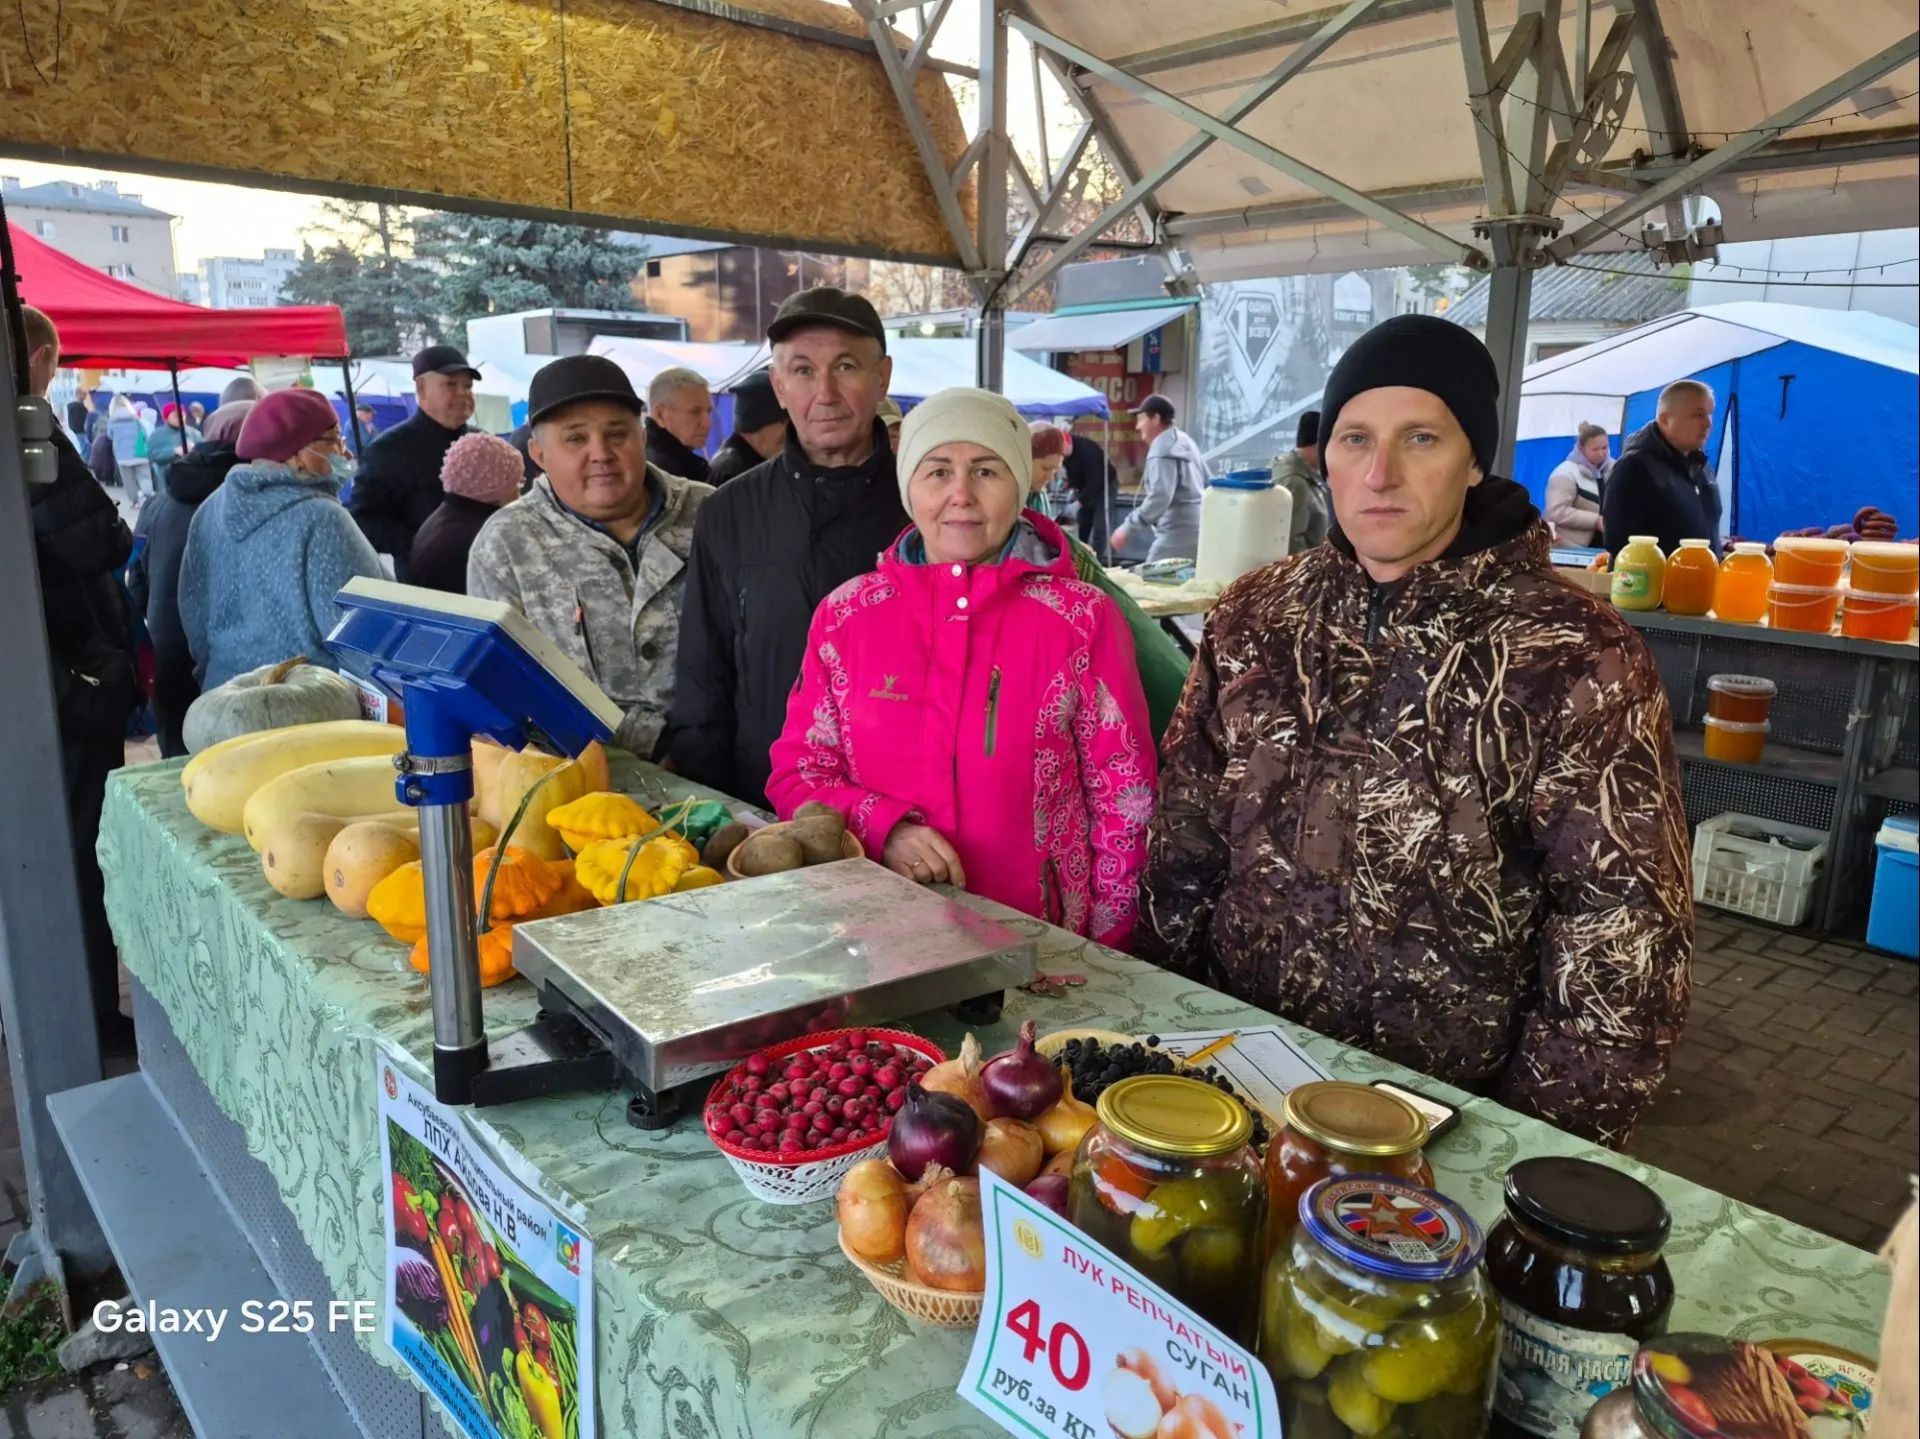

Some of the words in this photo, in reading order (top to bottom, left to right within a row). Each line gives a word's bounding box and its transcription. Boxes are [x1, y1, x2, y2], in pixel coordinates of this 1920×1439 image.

[424, 1119, 451, 1160] ЛПХ
[494, 1199, 521, 1249] Н.В.
[516, 1205, 548, 1240] район
[1006, 1298, 1091, 1392] 40
[1063, 1246, 1105, 1287] ЛУК
[1111, 1276, 1248, 1381] РЕПЧАТЫЙ
[1166, 1340, 1251, 1409] СУГАН
